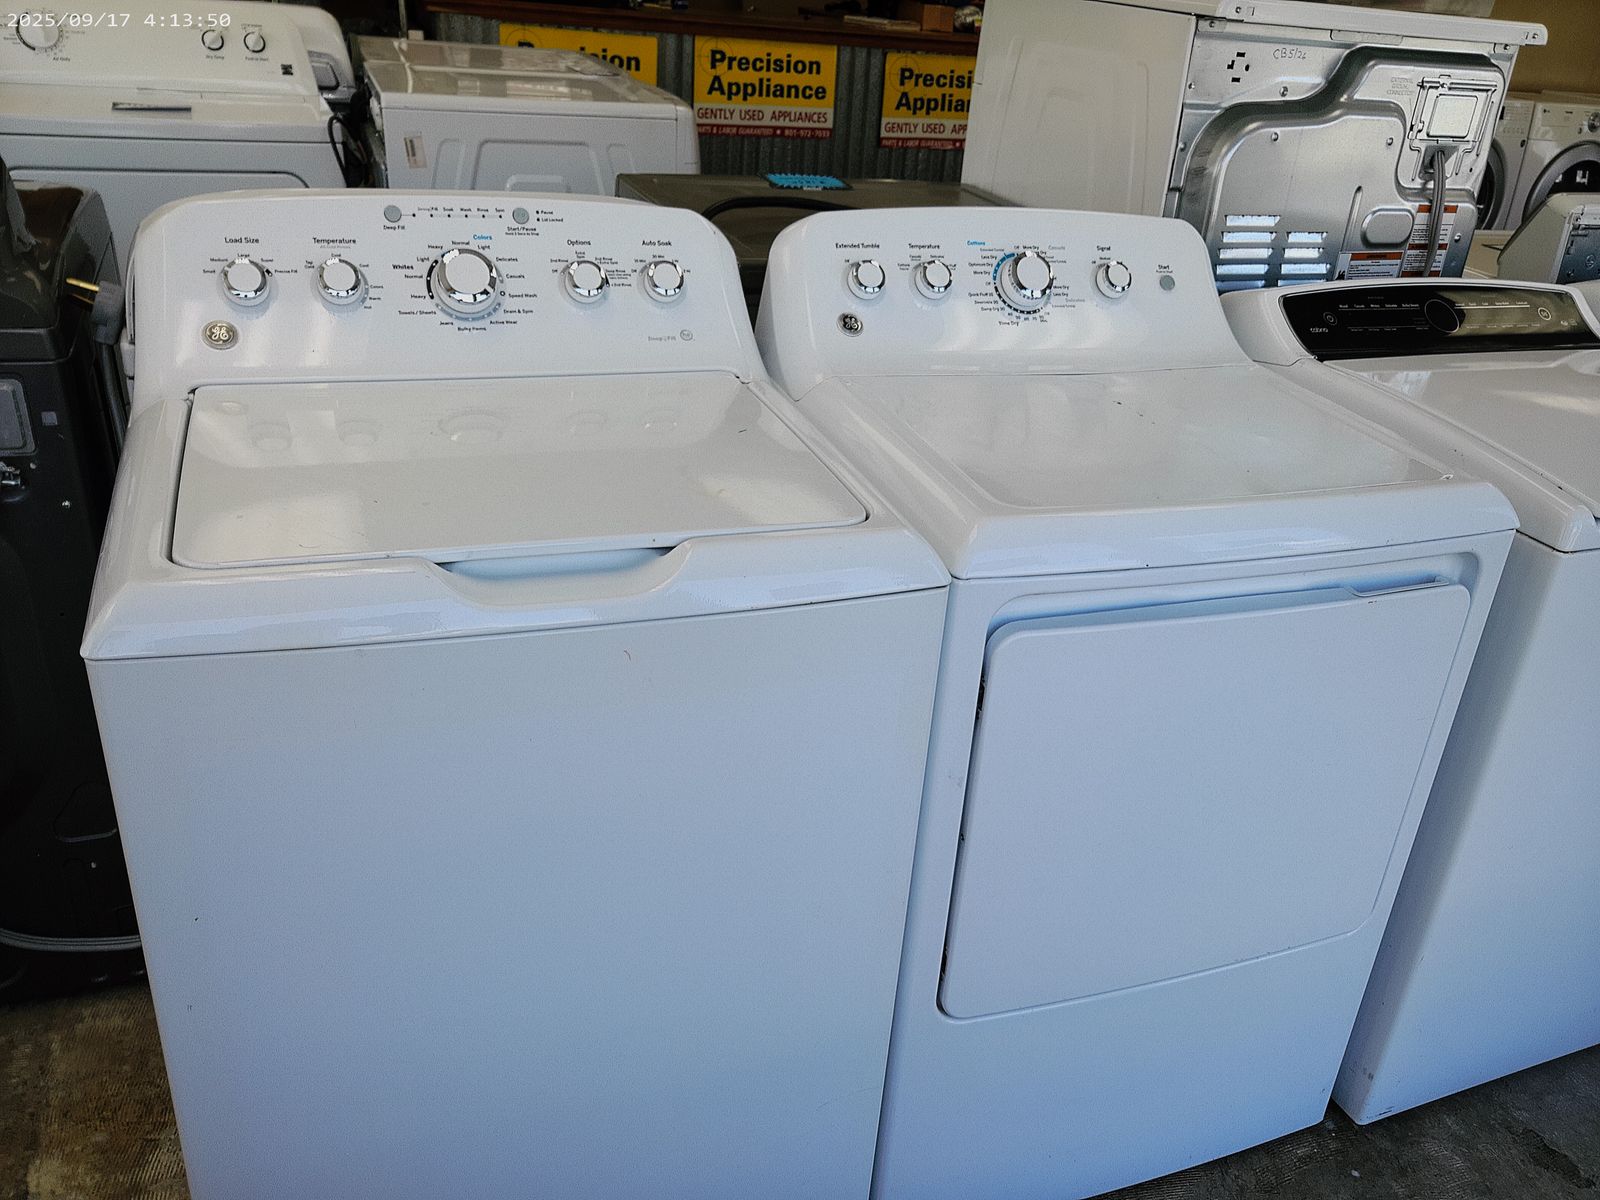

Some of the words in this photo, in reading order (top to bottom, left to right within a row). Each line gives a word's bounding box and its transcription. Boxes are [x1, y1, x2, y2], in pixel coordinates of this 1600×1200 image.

[710, 48, 821, 75] Precision
[899, 67, 973, 89] Precisi
[706, 75, 827, 101] Appliance
[697, 107, 735, 121] GENTLY
[739, 109, 765, 121] USED
[770, 110, 828, 123] APPLIANCES
[884, 122, 919, 134] GENTLY
[921, 123, 946, 135] USED
[313, 237, 356, 245] Temperature
[567, 239, 591, 247] Options
